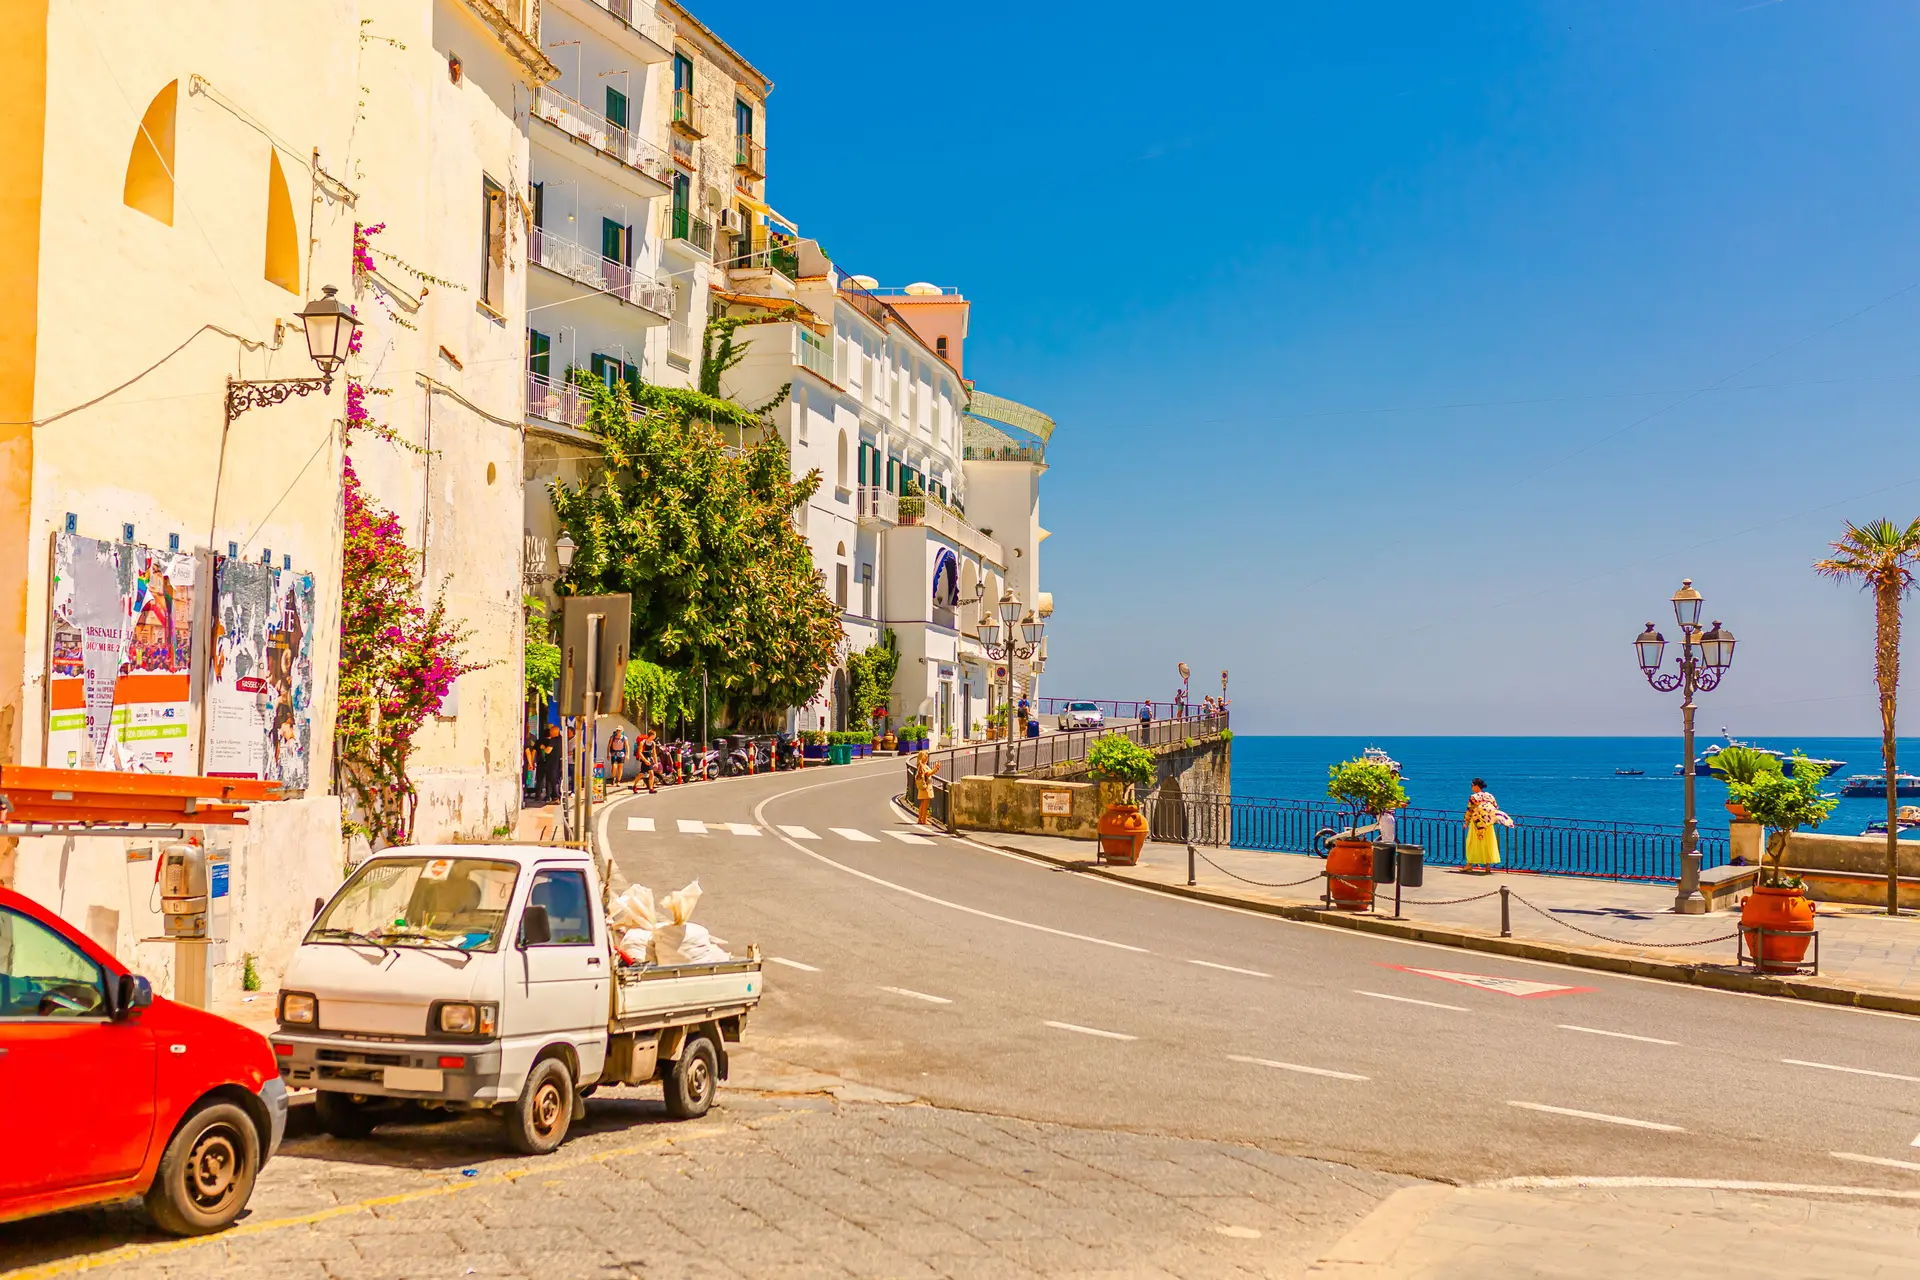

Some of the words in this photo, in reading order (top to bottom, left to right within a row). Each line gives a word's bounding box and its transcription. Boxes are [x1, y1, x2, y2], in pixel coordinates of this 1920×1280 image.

[69, 514, 75, 530] 8
[126, 525, 133, 540] 9
[170, 535, 179, 549] 10
[229, 543, 237, 557] 11
[263, 549, 271, 563] 12
[86, 626, 118, 639] ARSENALE
[86, 641, 115, 653] DICMBRE
[87, 669, 95, 679] 16
[86, 716, 95, 726] 30
